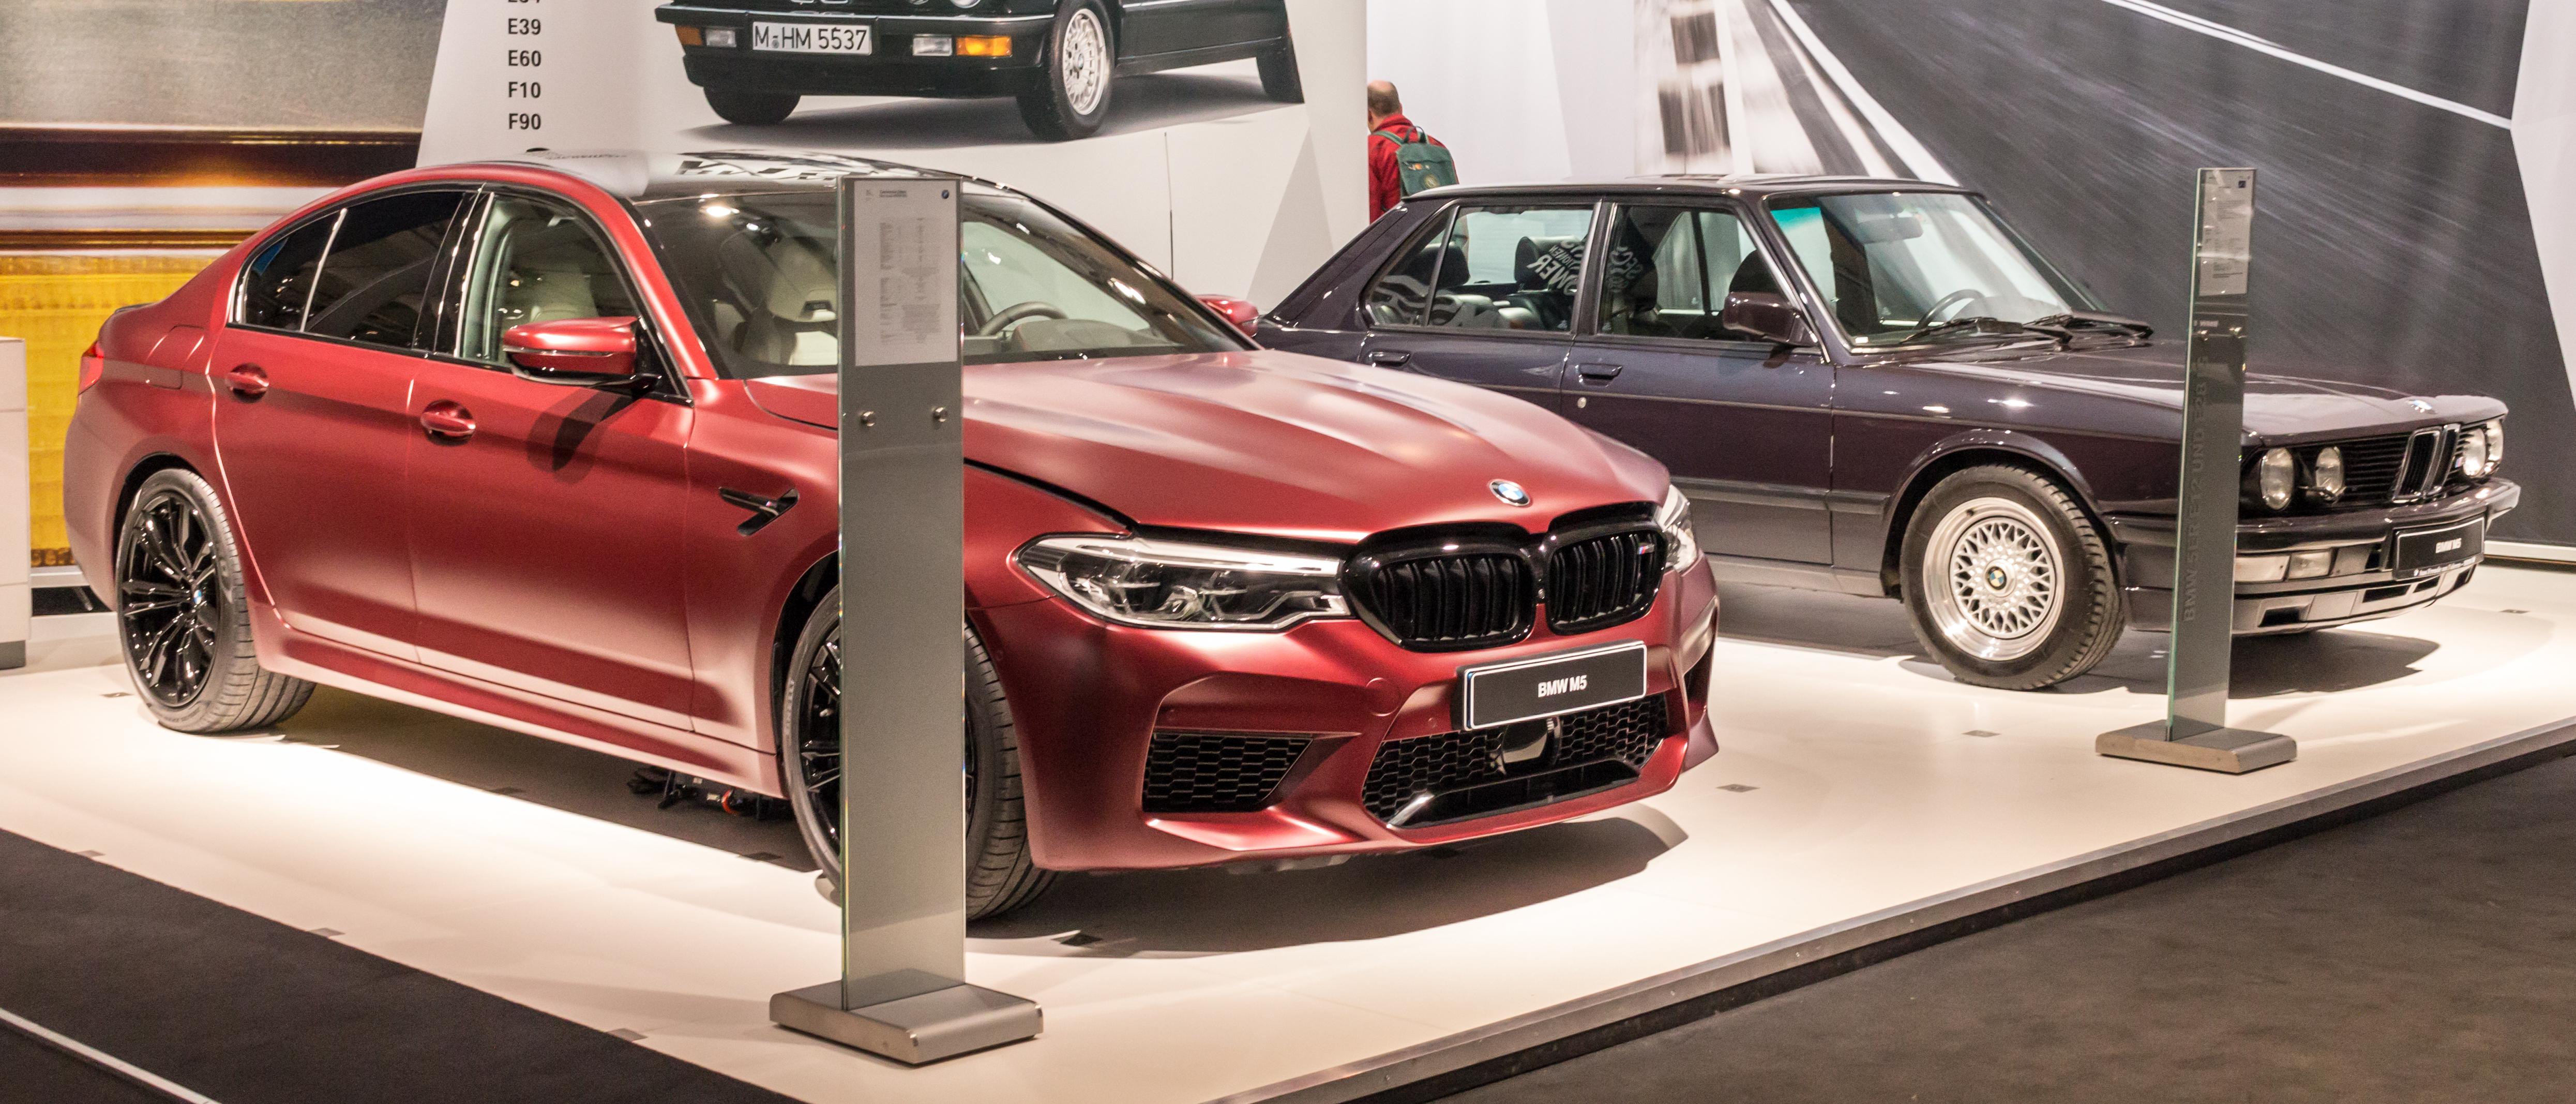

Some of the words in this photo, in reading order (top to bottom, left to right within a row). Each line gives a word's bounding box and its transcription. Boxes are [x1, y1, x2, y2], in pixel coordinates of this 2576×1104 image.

[508, 18, 541, 35] E39
[818, 27, 867, 51] 5537
[508, 50, 541, 67] E60
[508, 82, 541, 98] F10
[508, 113, 541, 129] F90
[2191, 428, 2205, 473] UND
[2189, 477, 2203, 517] E12
[2187, 521, 2201, 562] 5ER
[2184, 568, 2198, 621] BMW
[1538, 678, 1569, 697] BMW
[1569, 675, 1588, 692] M5
